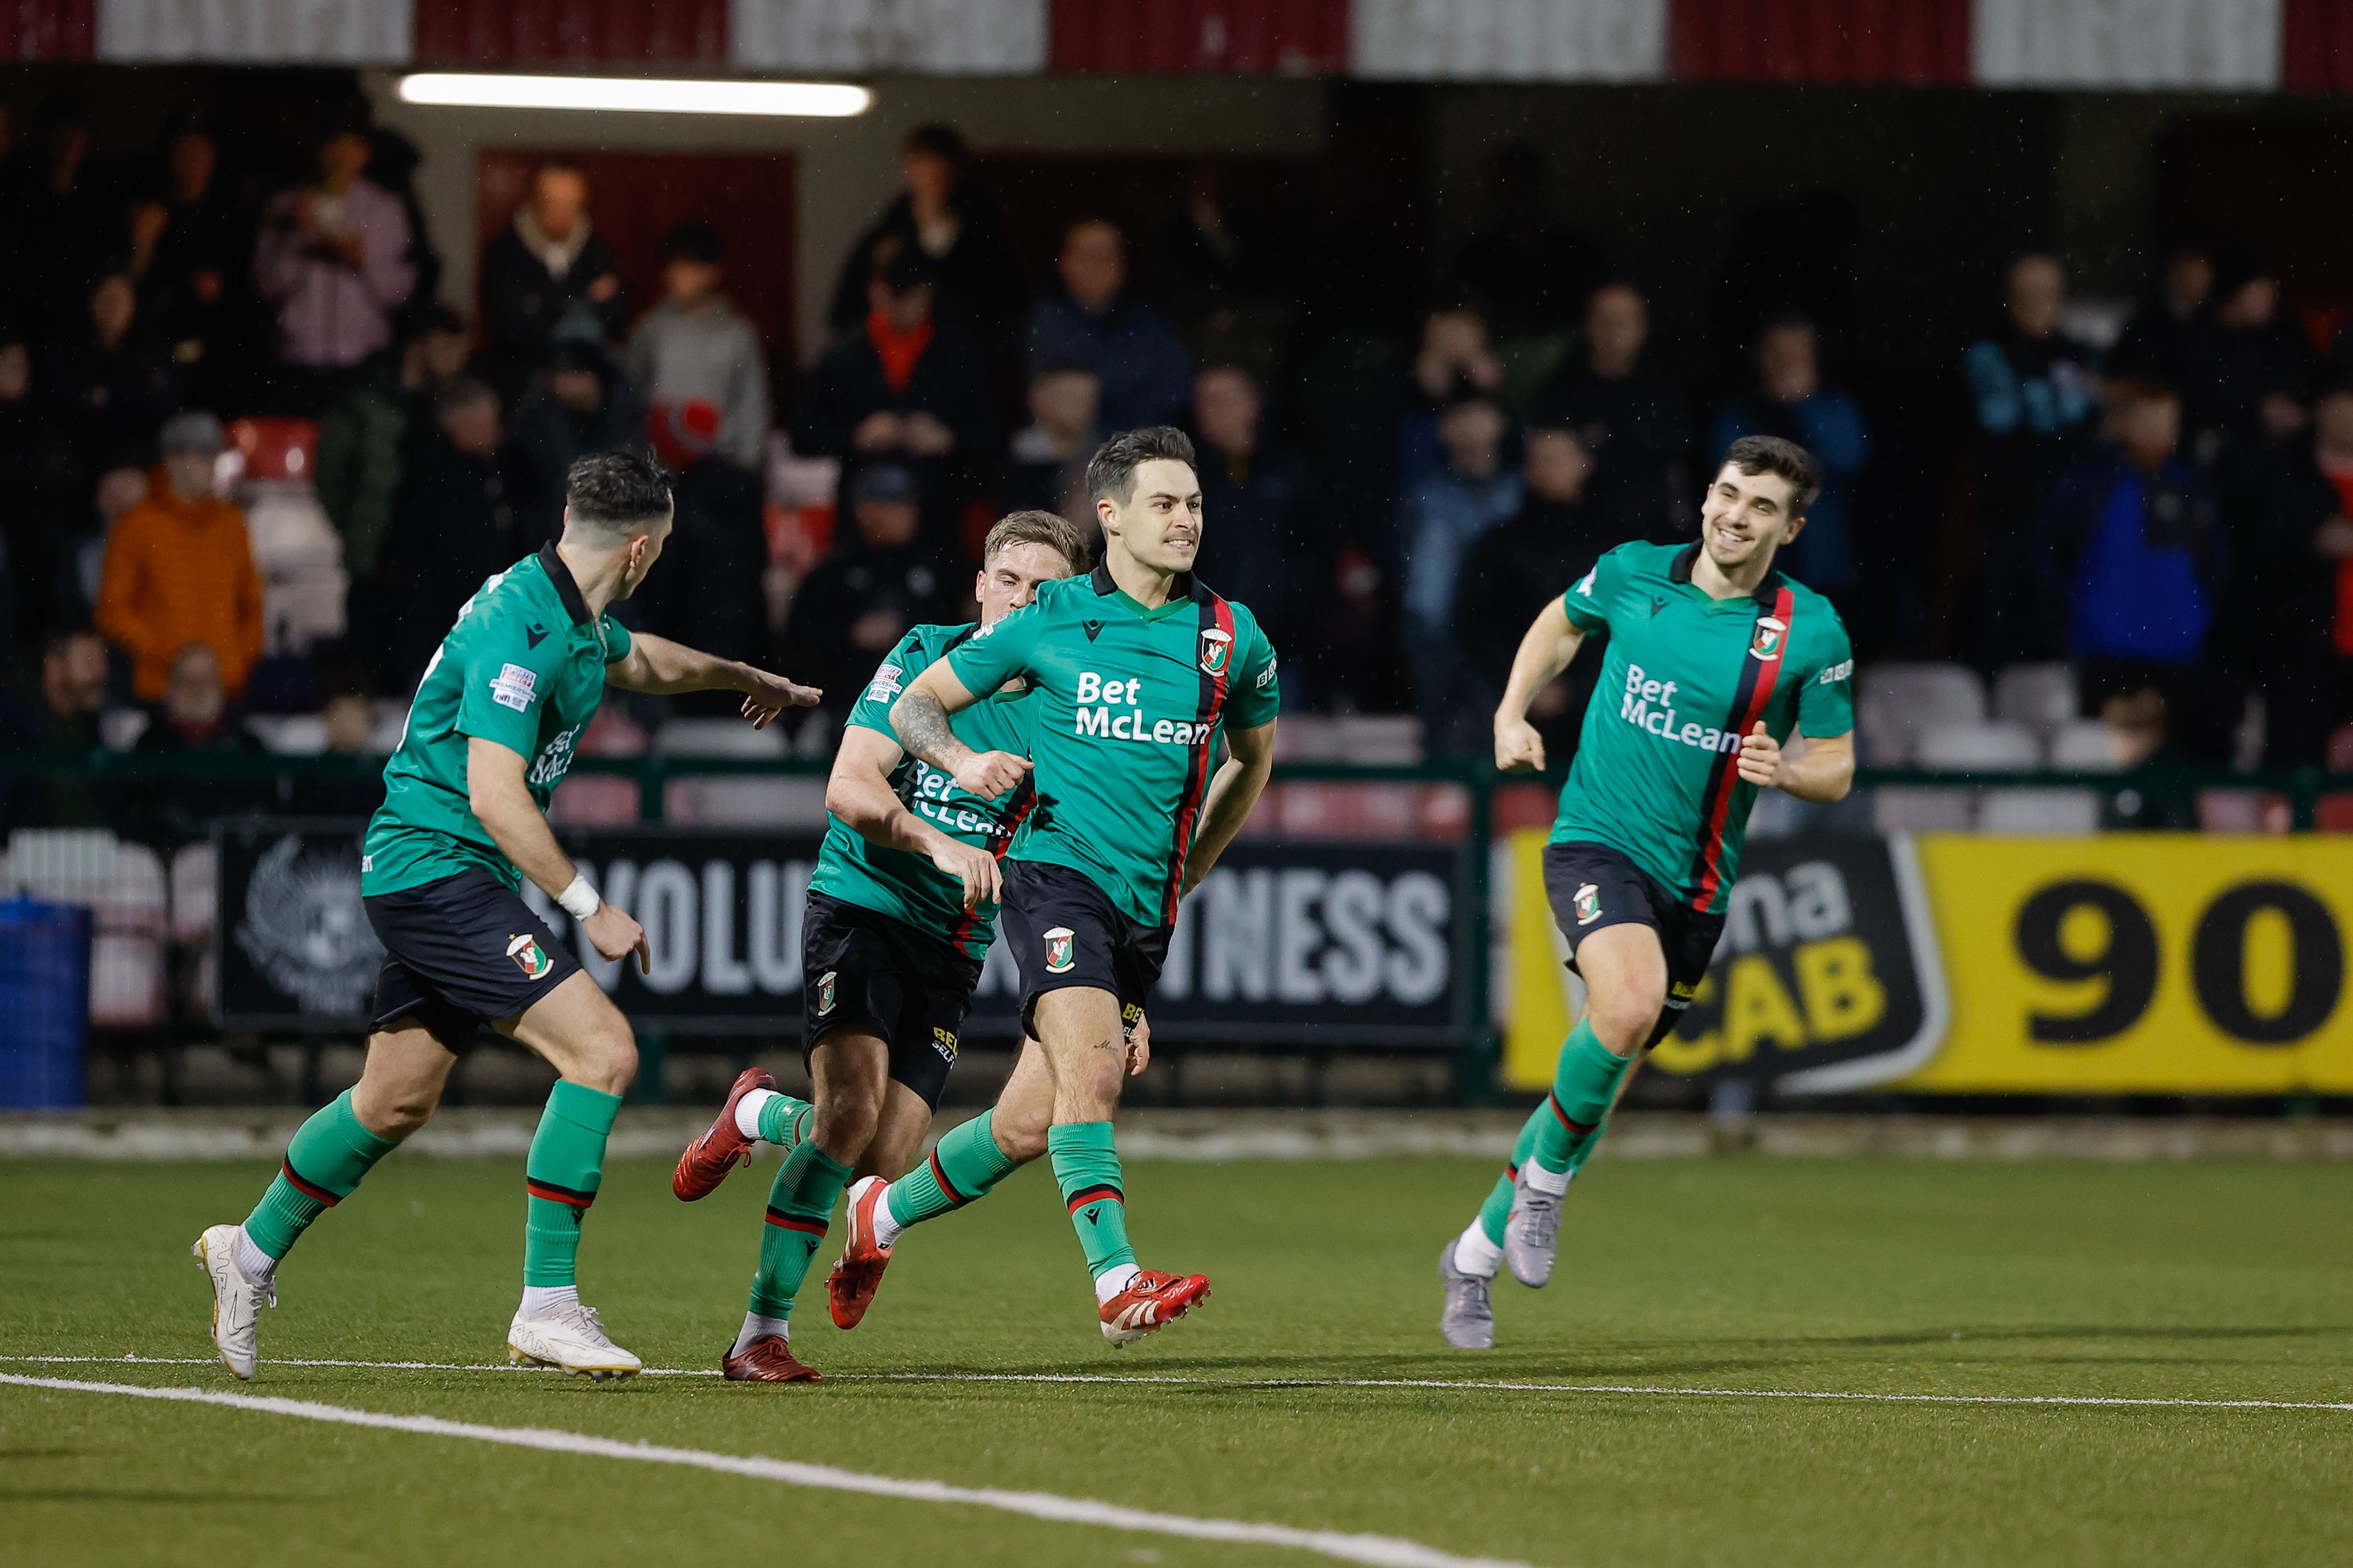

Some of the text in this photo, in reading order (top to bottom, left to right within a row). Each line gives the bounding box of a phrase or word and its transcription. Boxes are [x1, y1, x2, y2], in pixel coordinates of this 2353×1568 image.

[1076, 671, 1141, 706] Bet
[1625, 663, 1678, 708] Bet
[1076, 706, 1211, 745] McLean
[1620, 692, 1743, 754] McLean
[904, 758, 959, 802] Bet
[1710, 859, 1856, 966] na
[2013, 876, 2345, 1048] 90
